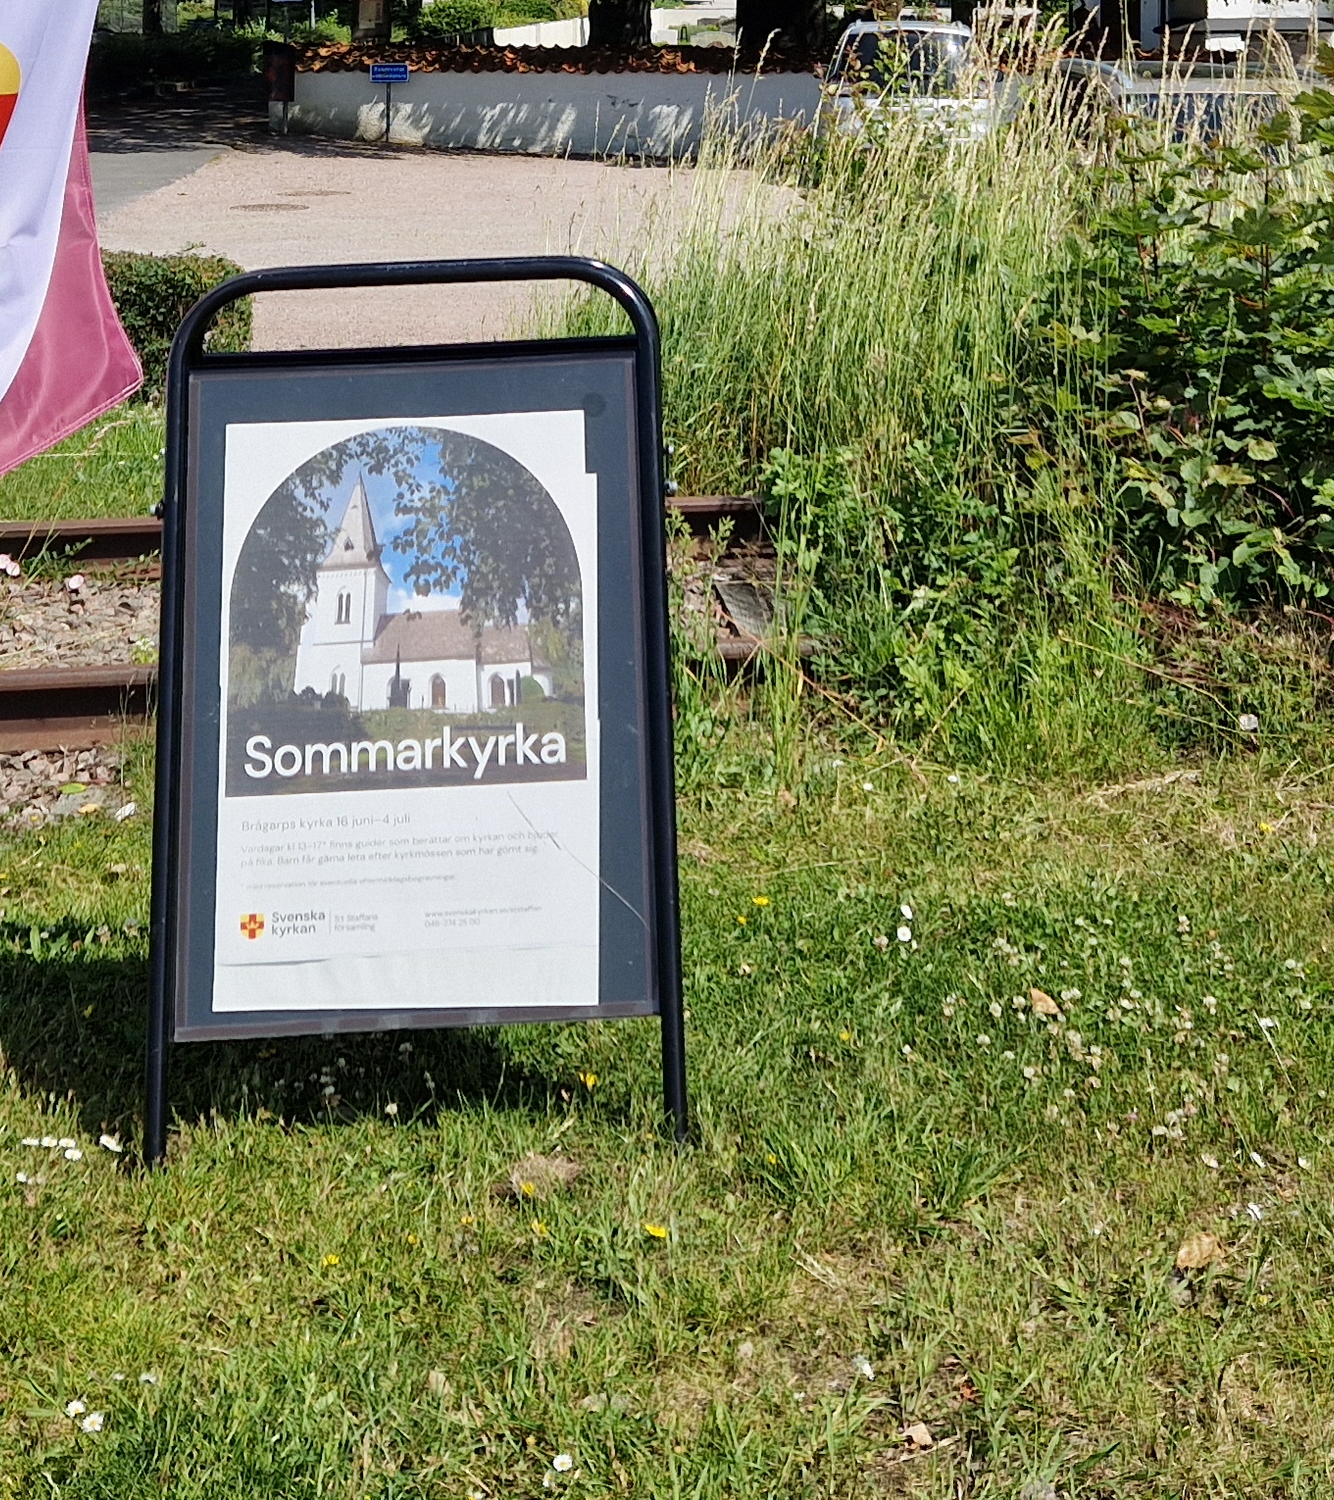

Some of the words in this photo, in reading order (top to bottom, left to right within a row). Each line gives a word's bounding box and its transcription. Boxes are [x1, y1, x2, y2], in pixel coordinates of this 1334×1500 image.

[244, 722, 566, 780] Sommarkyrka
[241, 820, 296, 833] Brågarps
[299, 818, 333, 830] kyrka
[336, 816, 348, 827] 16
[393, 813, 411, 826] juli
[240, 845, 284, 855] Vardagar
[330, 840, 353, 849] finns
[355, 838, 386, 849] guider
[389, 838, 410, 846] som
[412, 835, 452, 845] berättar
[454, 835, 470, 843] om
[472, 833, 505, 844] kyrkan
[507, 831, 525, 840] och
[240, 858, 253, 868] på
[277, 856, 299, 866] Barn
[302, 854, 315, 864] får
[318, 854, 345, 865] gärna
[347, 853, 366, 862] leta
[368, 851, 391, 861] efter
[394, 849, 453, 860] kyrkmössen
[478, 846, 495, 855] har
[497, 846, 521, 857] gömt
[272, 910, 326, 923] Svenska
[346, 912, 379, 922] Staffans
[271, 922, 316, 938] kyrkan
